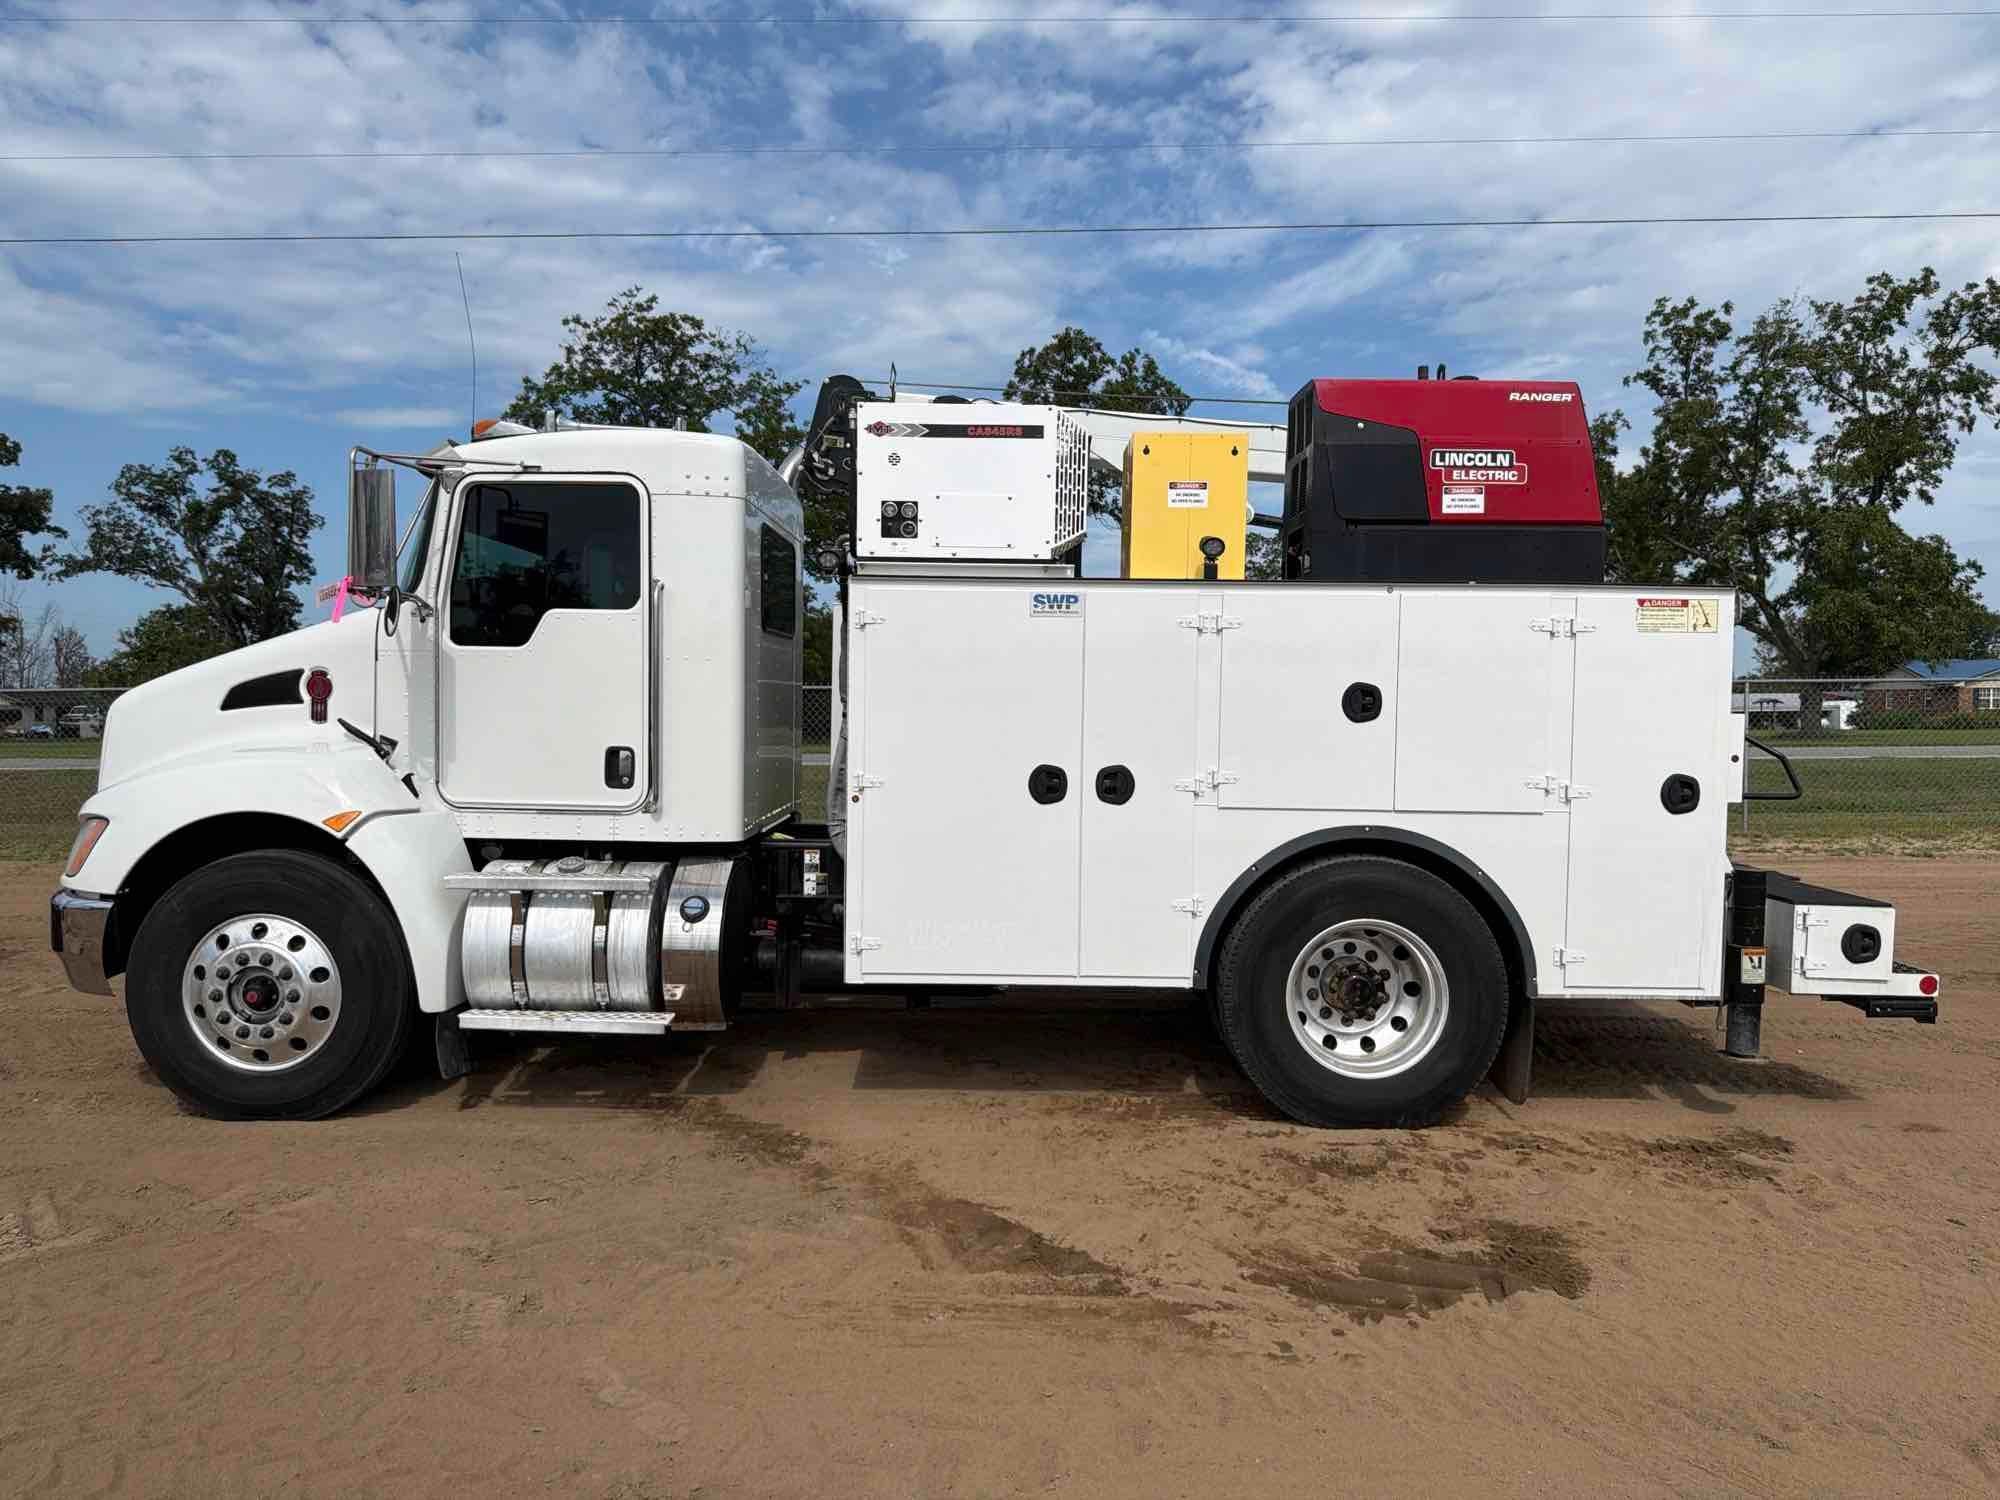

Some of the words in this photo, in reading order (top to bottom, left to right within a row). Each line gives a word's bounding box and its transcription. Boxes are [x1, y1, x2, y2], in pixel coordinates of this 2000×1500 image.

[1509, 392, 1573, 402] RANGER
[1434, 452, 1511, 467] LINCOLN
[1452, 470, 1519, 481] ELECTRIC
[1033, 594, 1080, 609] SWP
[1650, 599, 1682, 607] DANGER
